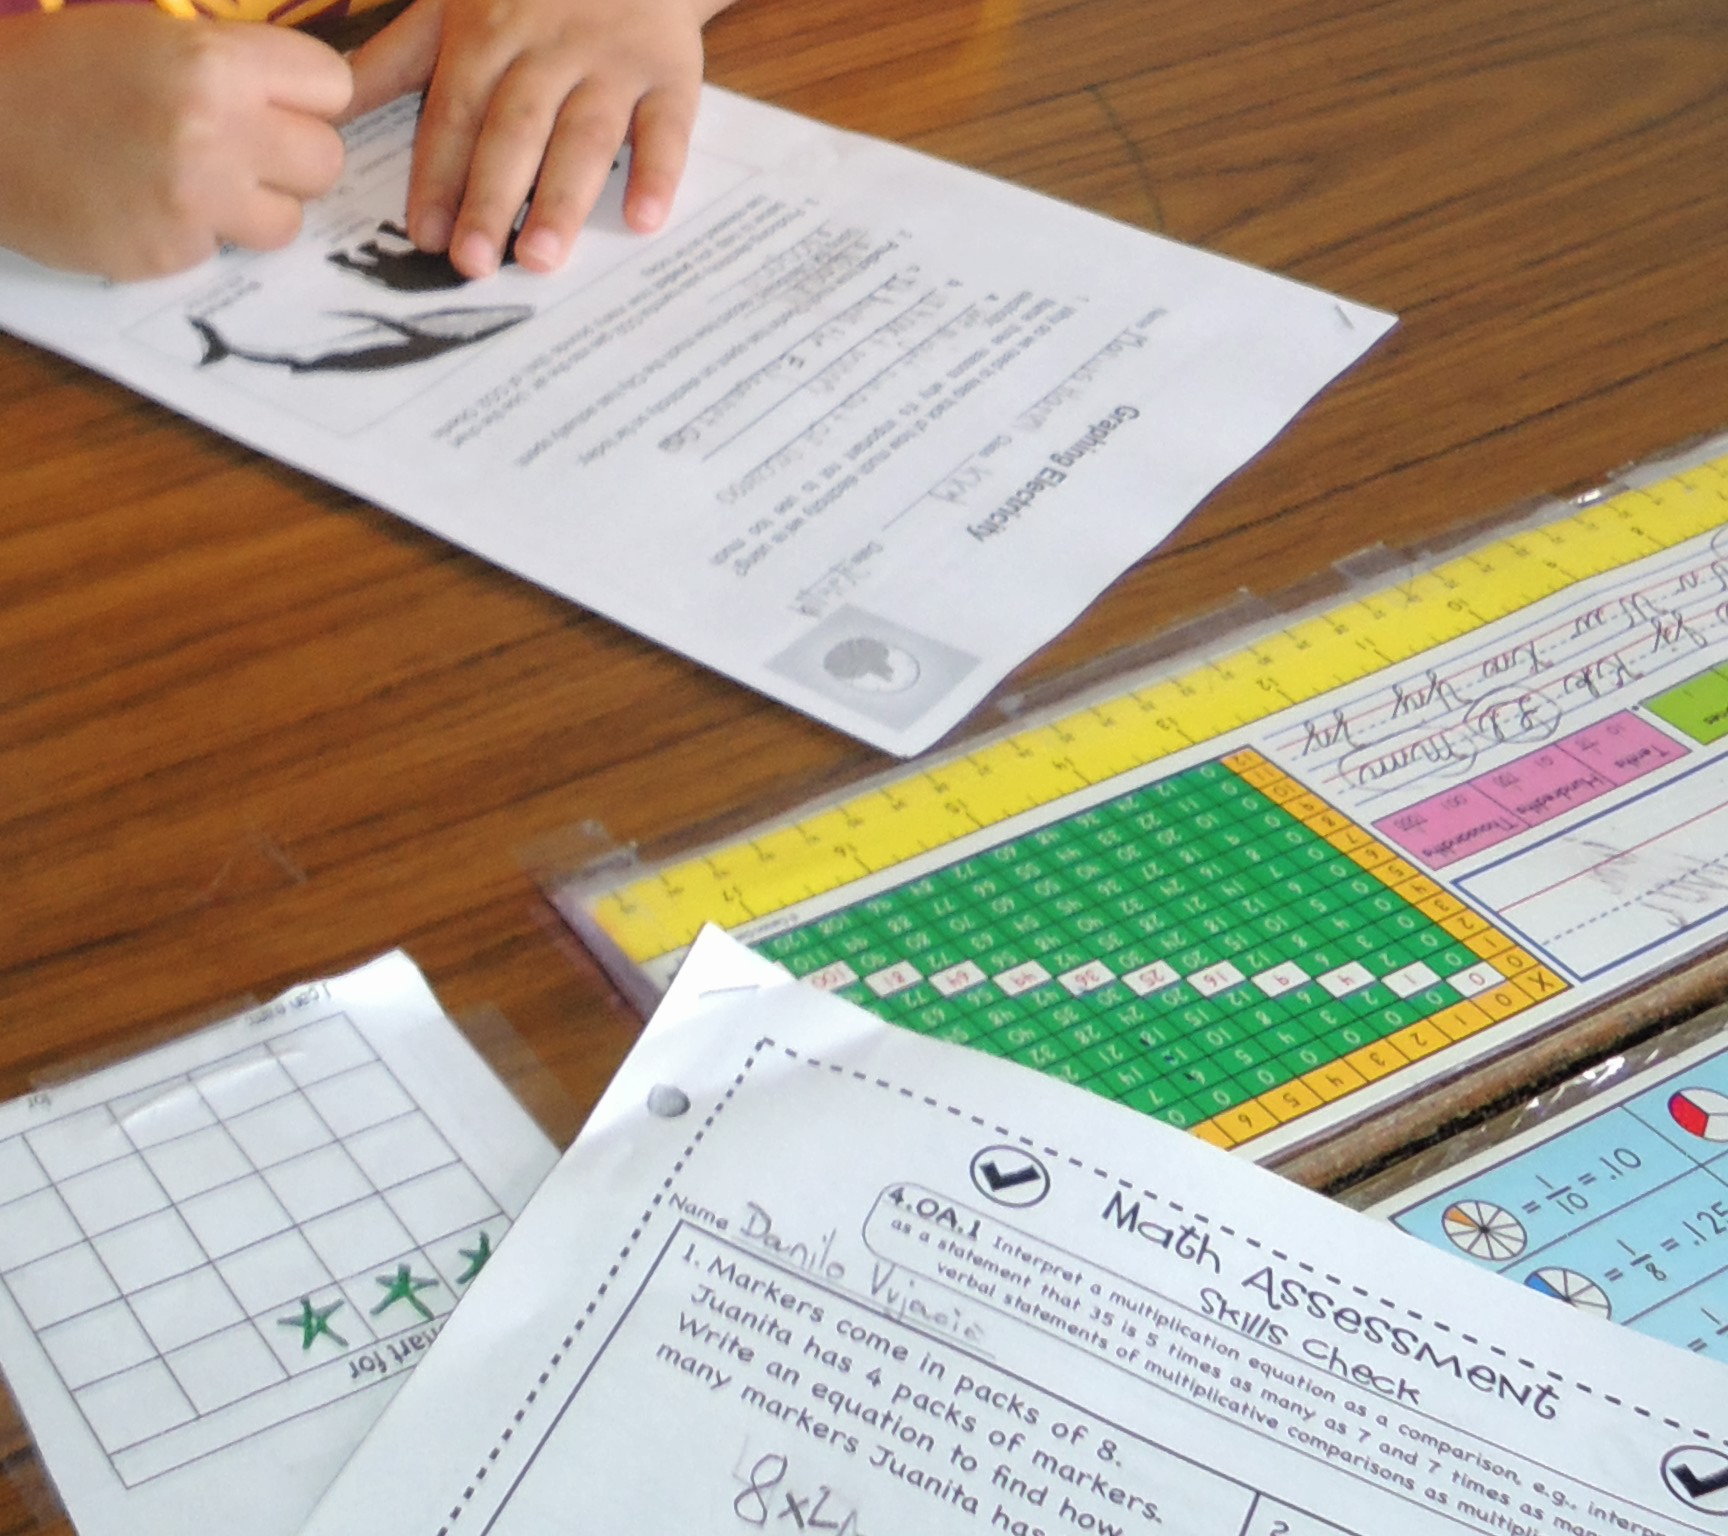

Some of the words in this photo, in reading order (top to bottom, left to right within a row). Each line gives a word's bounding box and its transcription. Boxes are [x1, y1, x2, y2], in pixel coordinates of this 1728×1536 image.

[967, 465, 1066, 542] Electricity
[1053, 405, 1140, 466] Graphing
[667, 1192, 729, 1233] Name
[740, 1201, 845, 1279] Danilo
[888, 1184, 981, 1241] 4.OA.1
[992, 1235, 1084, 1287] Interpret
[1089, 1283, 1102, 1297] a
[1108, 1290, 1240, 1363] multiplication
[1248, 1357, 1338, 1405] equation
[1343, 1398, 1369, 1420] as
[1375, 1408, 1395, 1429] a
[1101, 1192, 1221, 1277] Math
[1240, 1265, 1561, 1421] Assessment
[349, 1350, 385, 1381] for
[655, 1342, 733, 1392] many
[740, 1384, 860, 1457] markers
[868, 1444, 979, 1518] Juanita
[679, 1310, 755, 1365] Write
[765, 1361, 800, 1389] an
[811, 1382, 935, 1455] equation
[950, 1443, 978, 1476] to
[991, 1463, 1049, 1509] find
[1058, 1496, 1123, 1536] how
[681, 1241, 700, 1270] 1.
[707, 1254, 825, 1327] Markers
[833, 1319, 909, 1365] come
[918, 1351, 946, 1384] in
[953, 1374, 1044, 1429] packs
[1047, 1413, 1092, 1447] of
[1096, 1428, 1126, 1468] 8.
[689, 1283, 793, 1347] Juanita
[802, 1334, 853, 1375] has
[865, 1367, 882, 1390] 4
[891, 1382, 977, 1437] packs
[988, 1429, 1031, 1456] of
[1031, 1448, 1163, 1526] markers.
[890, 1219, 912, 1237] as
[918, 1230, 931, 1245] a
[937, 1237, 1032, 1289] statement
[1040, 1281, 1081, 1313] that
[1089, 1304, 1116, 1328] 35
[1121, 1318, 1138, 1341] is
[1144, 1331, 1160, 1350] 5
[1168, 1340, 1222, 1380] times
[1229, 1373, 1253, 1394] as
[1259, 1382, 1317, 1423] many
[1324, 1414, 1349, 1437] as
[1353, 1424, 1373, 1445] 7
[1378, 1437, 1420, 1468] and
[1427, 1457, 1442, 1475] 7
[1451, 1469, 1514, 1509] times
[1516, 1498, 1546, 1522] as
[937, 1261, 997, 1299] verbal
[1002, 1292, 1110, 1352] statements
[1115, 1346, 1141, 1365] of
[1143, 1358, 1279, 1432] multiplicative
[1284, 1420, 1416, 1492] comparisons
[1424, 1487, 1450, 1507] as
[1200, 1286, 1291, 1348] Skills
[1301, 1338, 1422, 1407] Check
